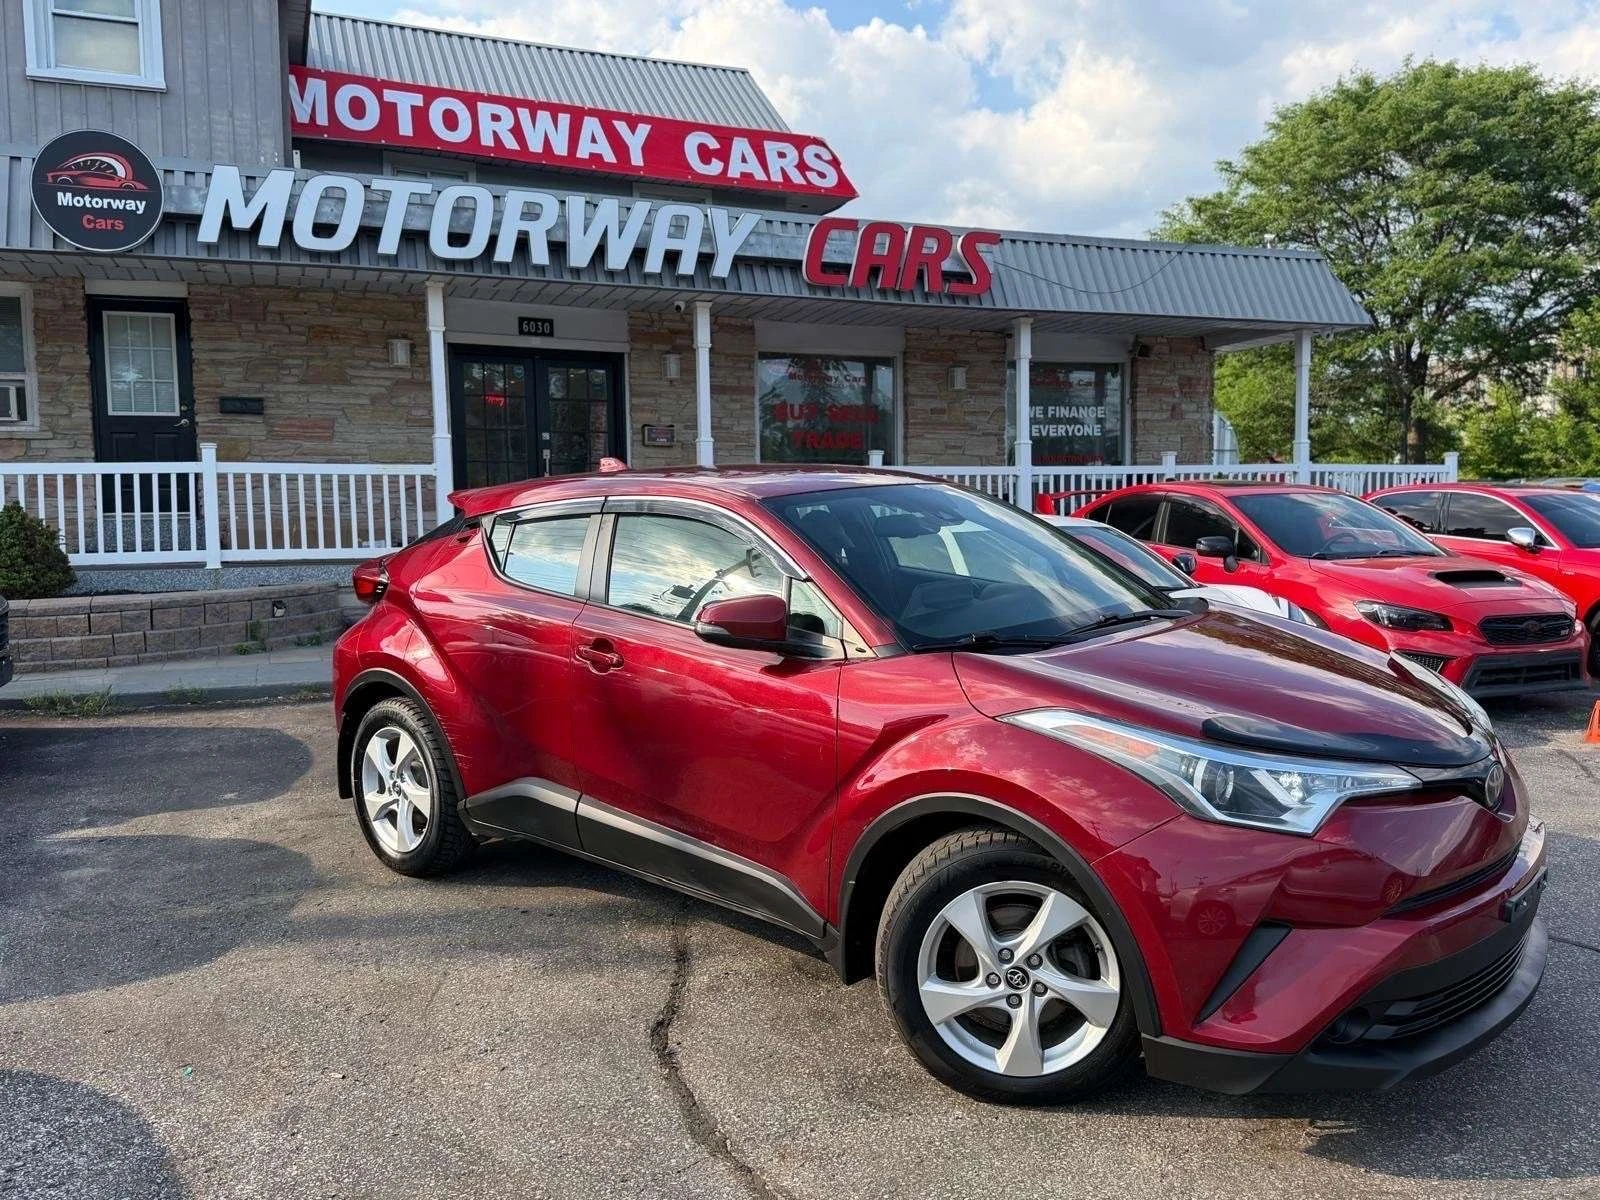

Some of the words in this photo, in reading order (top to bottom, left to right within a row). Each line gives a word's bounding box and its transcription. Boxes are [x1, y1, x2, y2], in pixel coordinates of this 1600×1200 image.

[289, 74, 652, 167] MOTORWAY
[683, 131, 839, 189] CARS
[57, 191, 146, 214] Motorway
[82, 214, 125, 231] Cars
[197, 164, 763, 279] MOTORWAY
[803, 216, 1001, 297] CARS
[522, 320, 551, 334] 6030
[1047, 405, 1105, 418] FINANCE
[1031, 424, 1102, 437] EVERYONE
